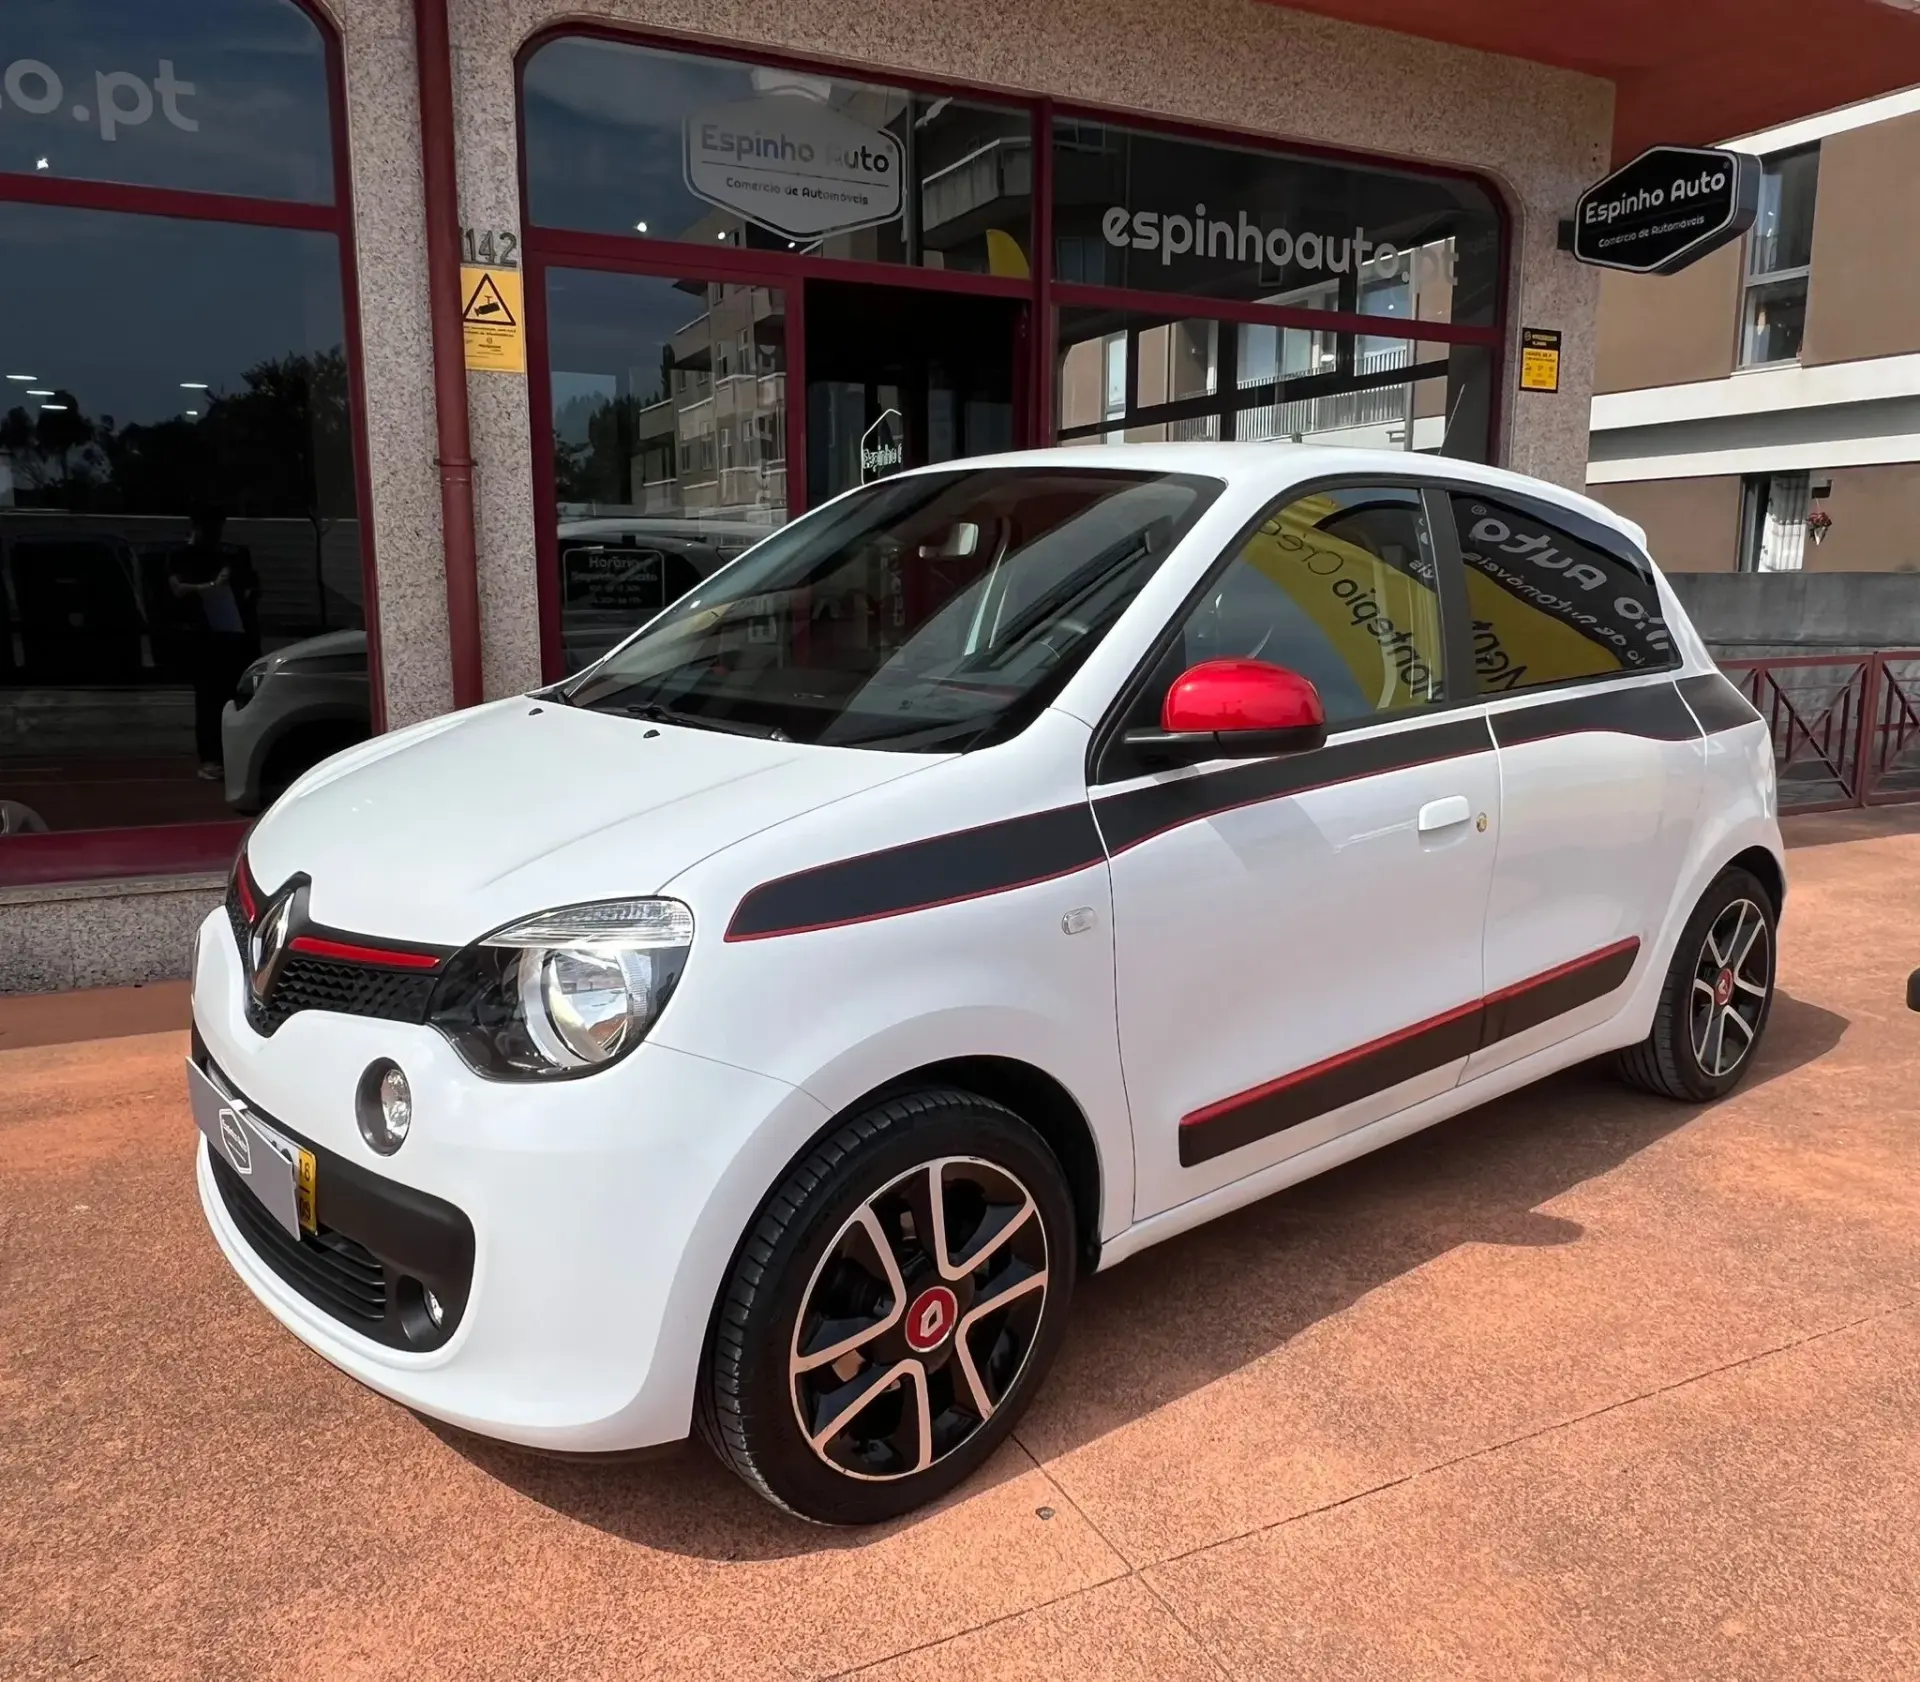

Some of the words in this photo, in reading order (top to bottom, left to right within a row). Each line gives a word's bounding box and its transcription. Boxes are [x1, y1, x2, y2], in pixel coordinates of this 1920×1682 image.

[701, 124, 815, 163] Espinho
[825, 144, 890, 173] Auto
[784, 184, 799, 197] de
[1585, 188, 1664, 224] Espinho
[1670, 171, 1726, 202] Auto
[465, 227, 517, 268] 142
[1102, 203, 1460, 292] espinhoauto.pt
[1638, 228, 1650, 239] de
